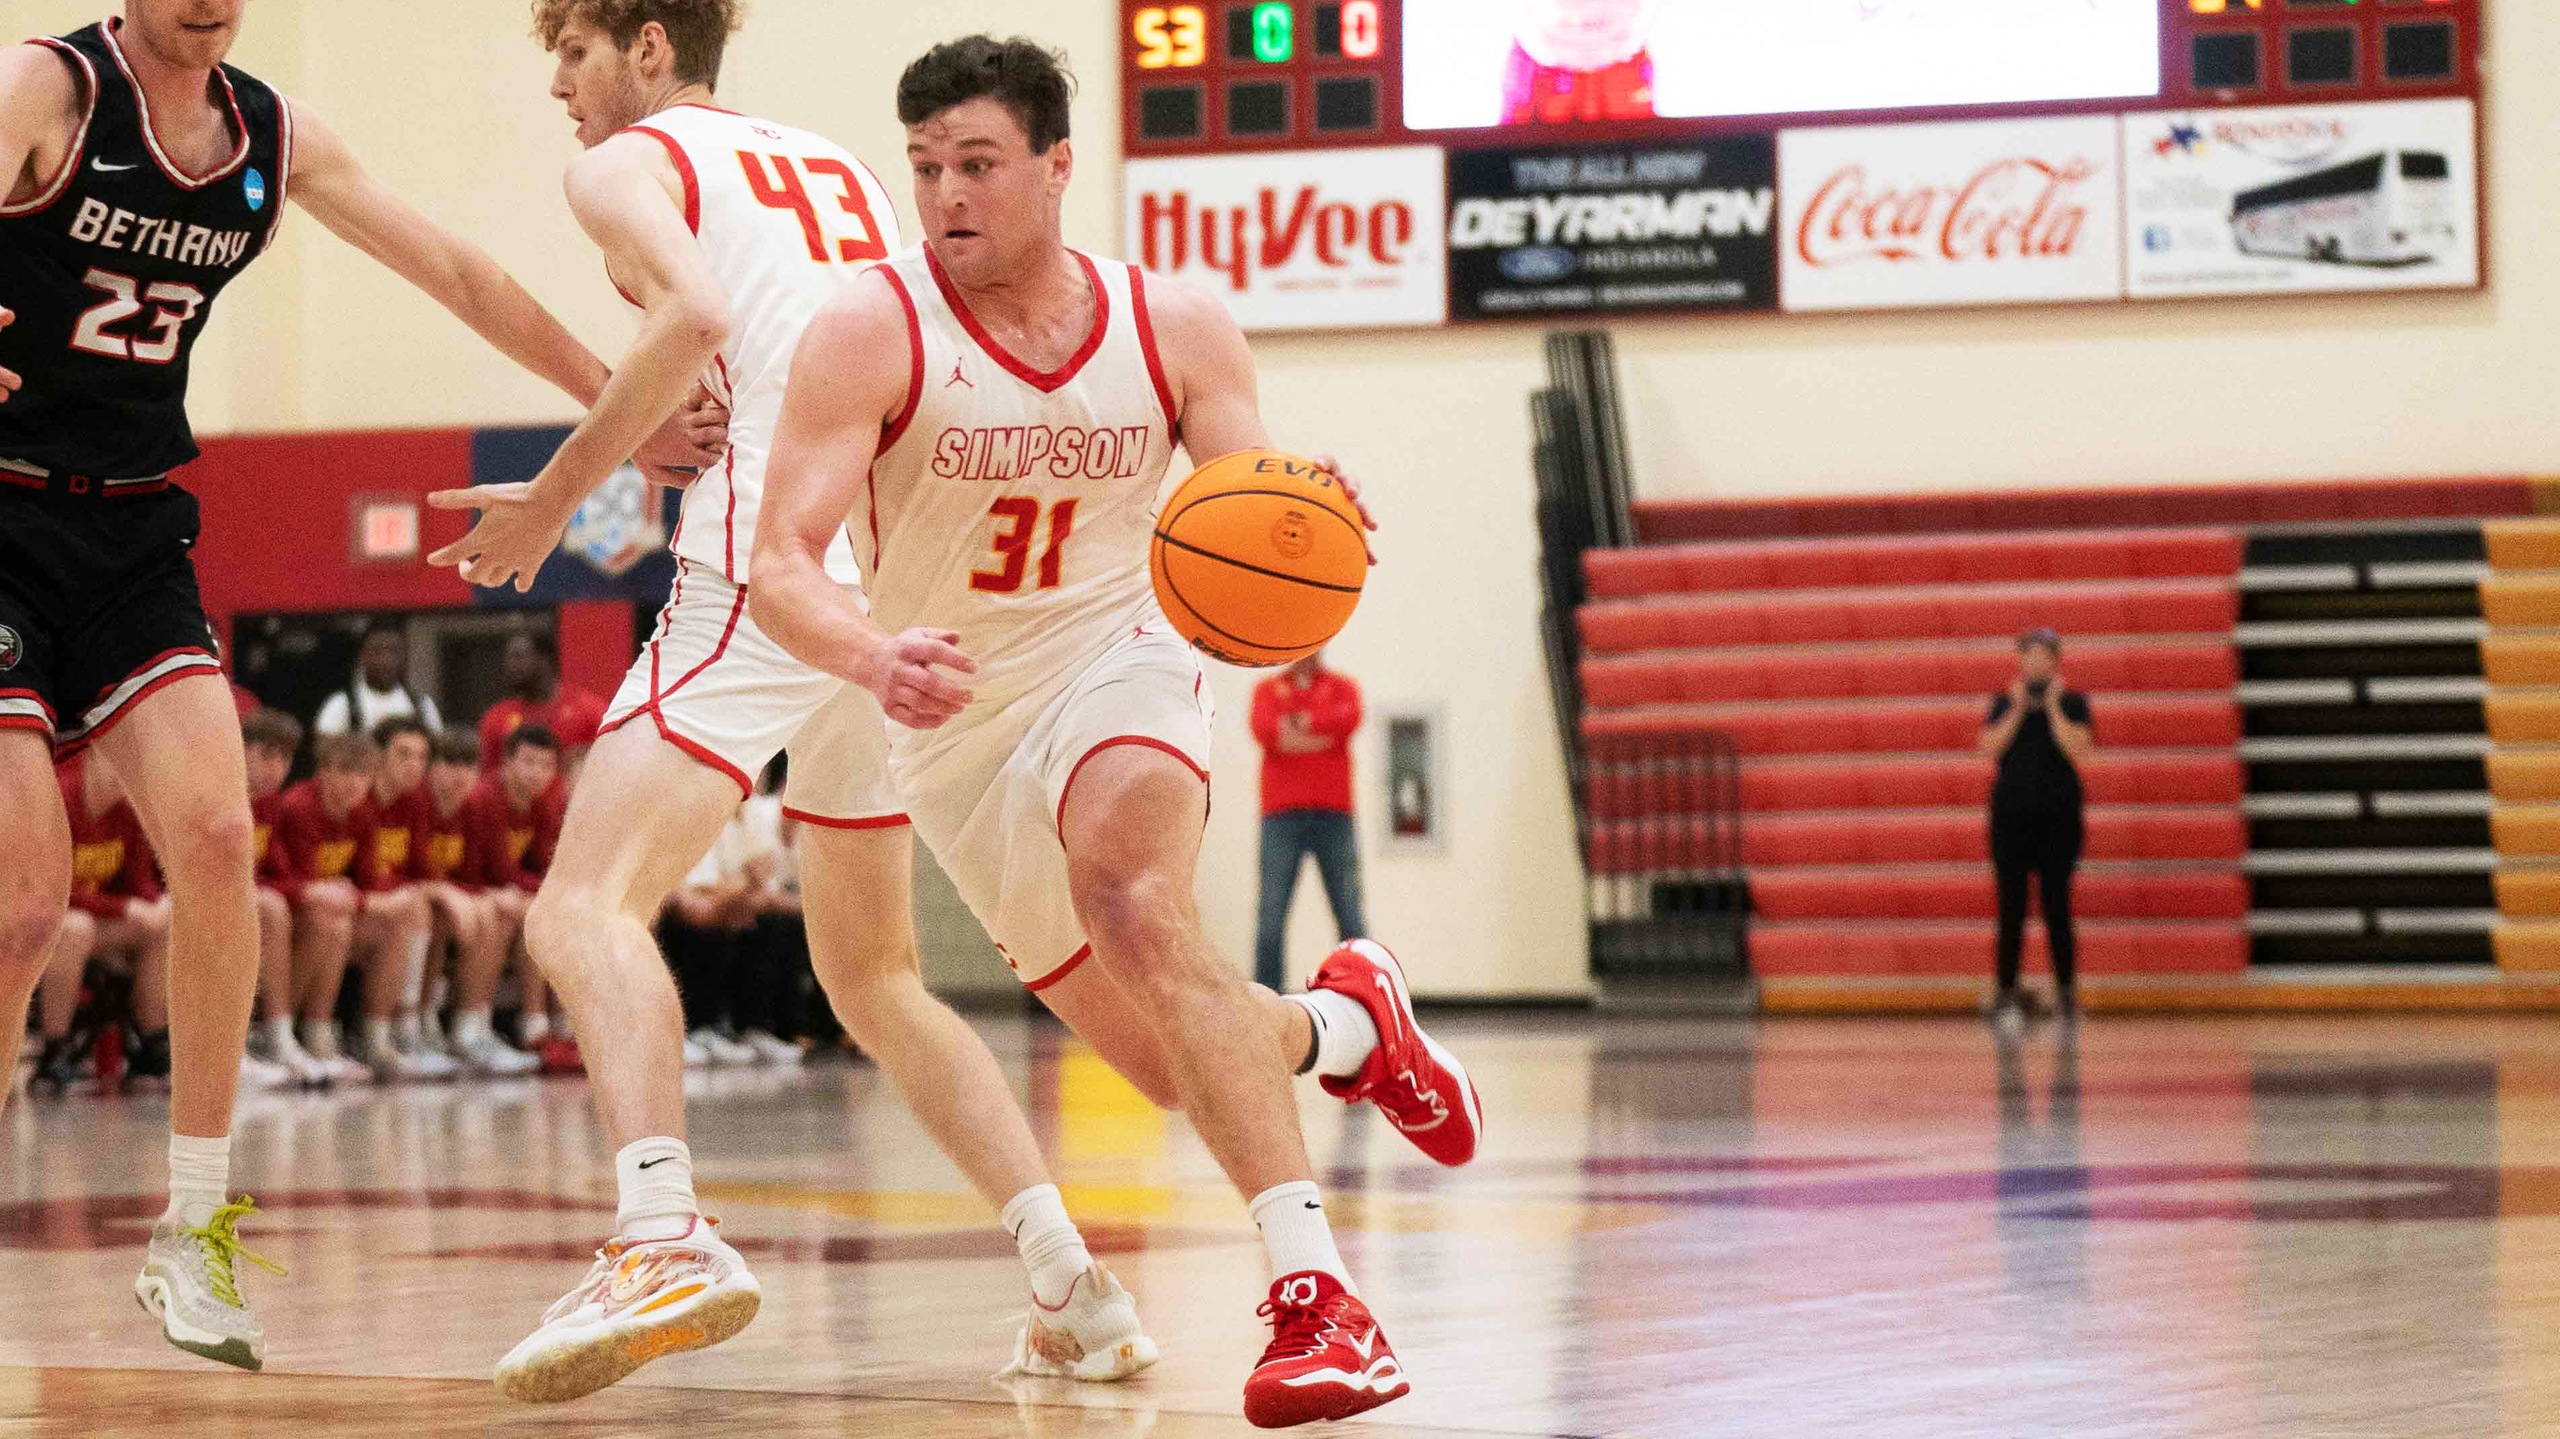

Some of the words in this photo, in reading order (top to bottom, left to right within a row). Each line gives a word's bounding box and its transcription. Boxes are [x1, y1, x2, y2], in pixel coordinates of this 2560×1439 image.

[1133, 5, 1206, 69] 53
[1252, 1, 1292, 63] 0
[1339, 0, 1382, 59] 0
[69, 197, 250, 268] BETHANY
[734, 150, 890, 264] 43
[1140, 183, 1412, 291] HyVee
[1451, 187, 1773, 247] DEYARMAN
[1797, 157, 2096, 268] Coca-Cola
[68, 266, 204, 364] 23
[931, 425, 1149, 481] SIMPSON
[968, 496, 1082, 594] 31
